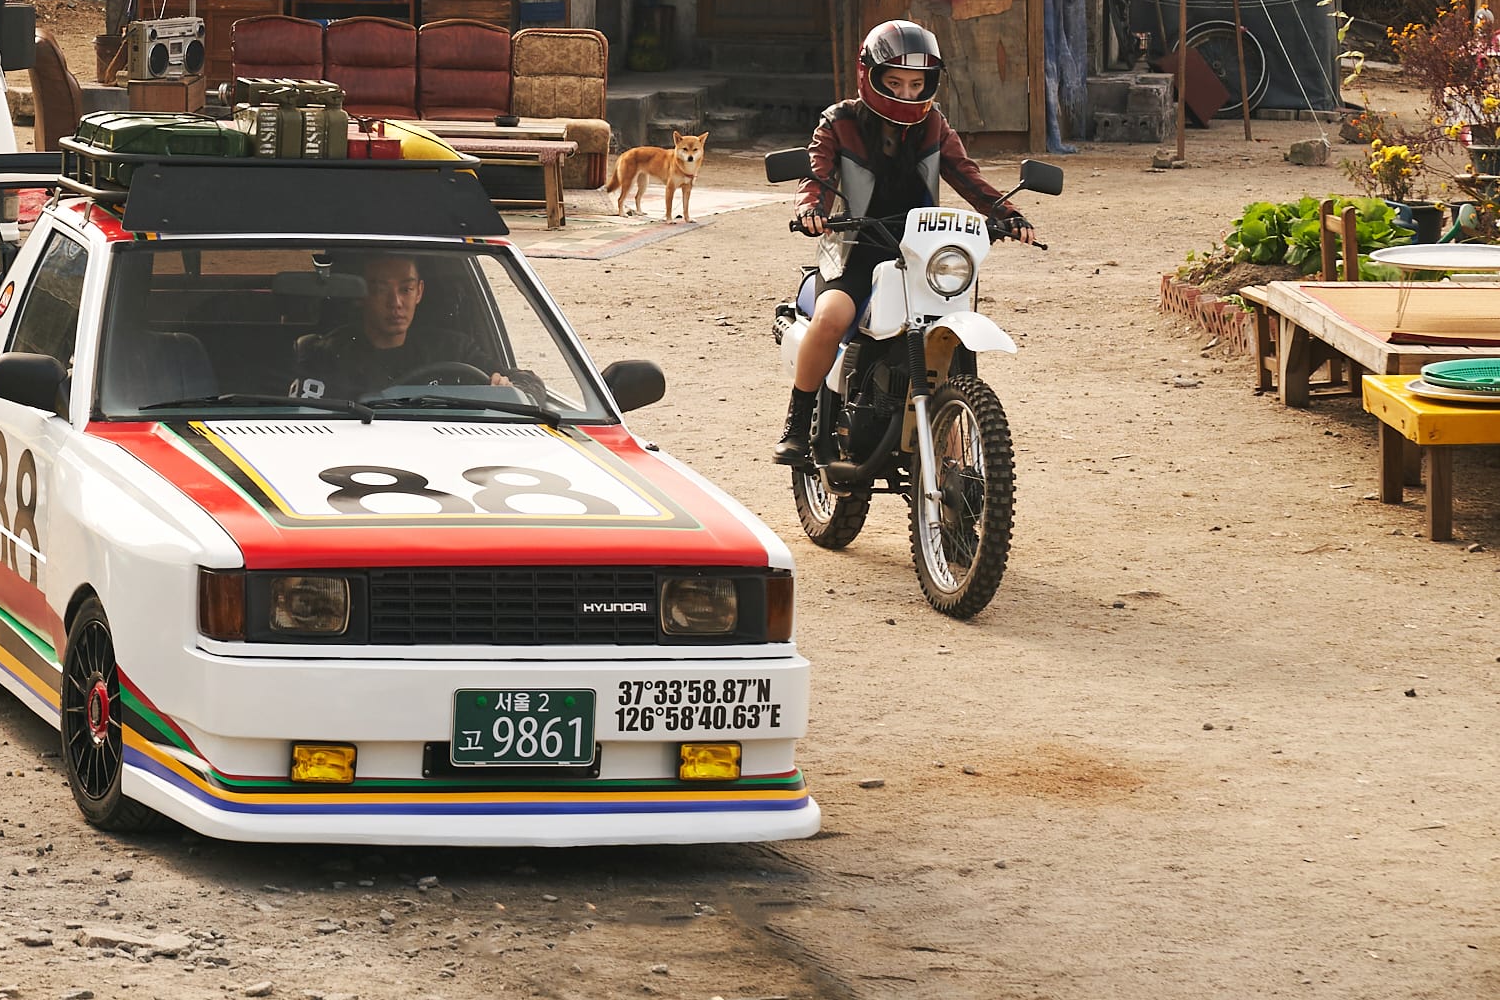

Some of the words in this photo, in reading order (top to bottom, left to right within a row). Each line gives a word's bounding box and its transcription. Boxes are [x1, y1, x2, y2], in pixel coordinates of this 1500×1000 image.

[917, 211, 981, 236] HUSTLER
[318, 464, 621, 515] 88
[583, 603, 648, 613] HYUNDAI
[494, 692, 531, 713] 서울
[538, 693, 550, 712] 2
[458, 730, 484, 752] 고
[492, 716, 582, 759] 9861
